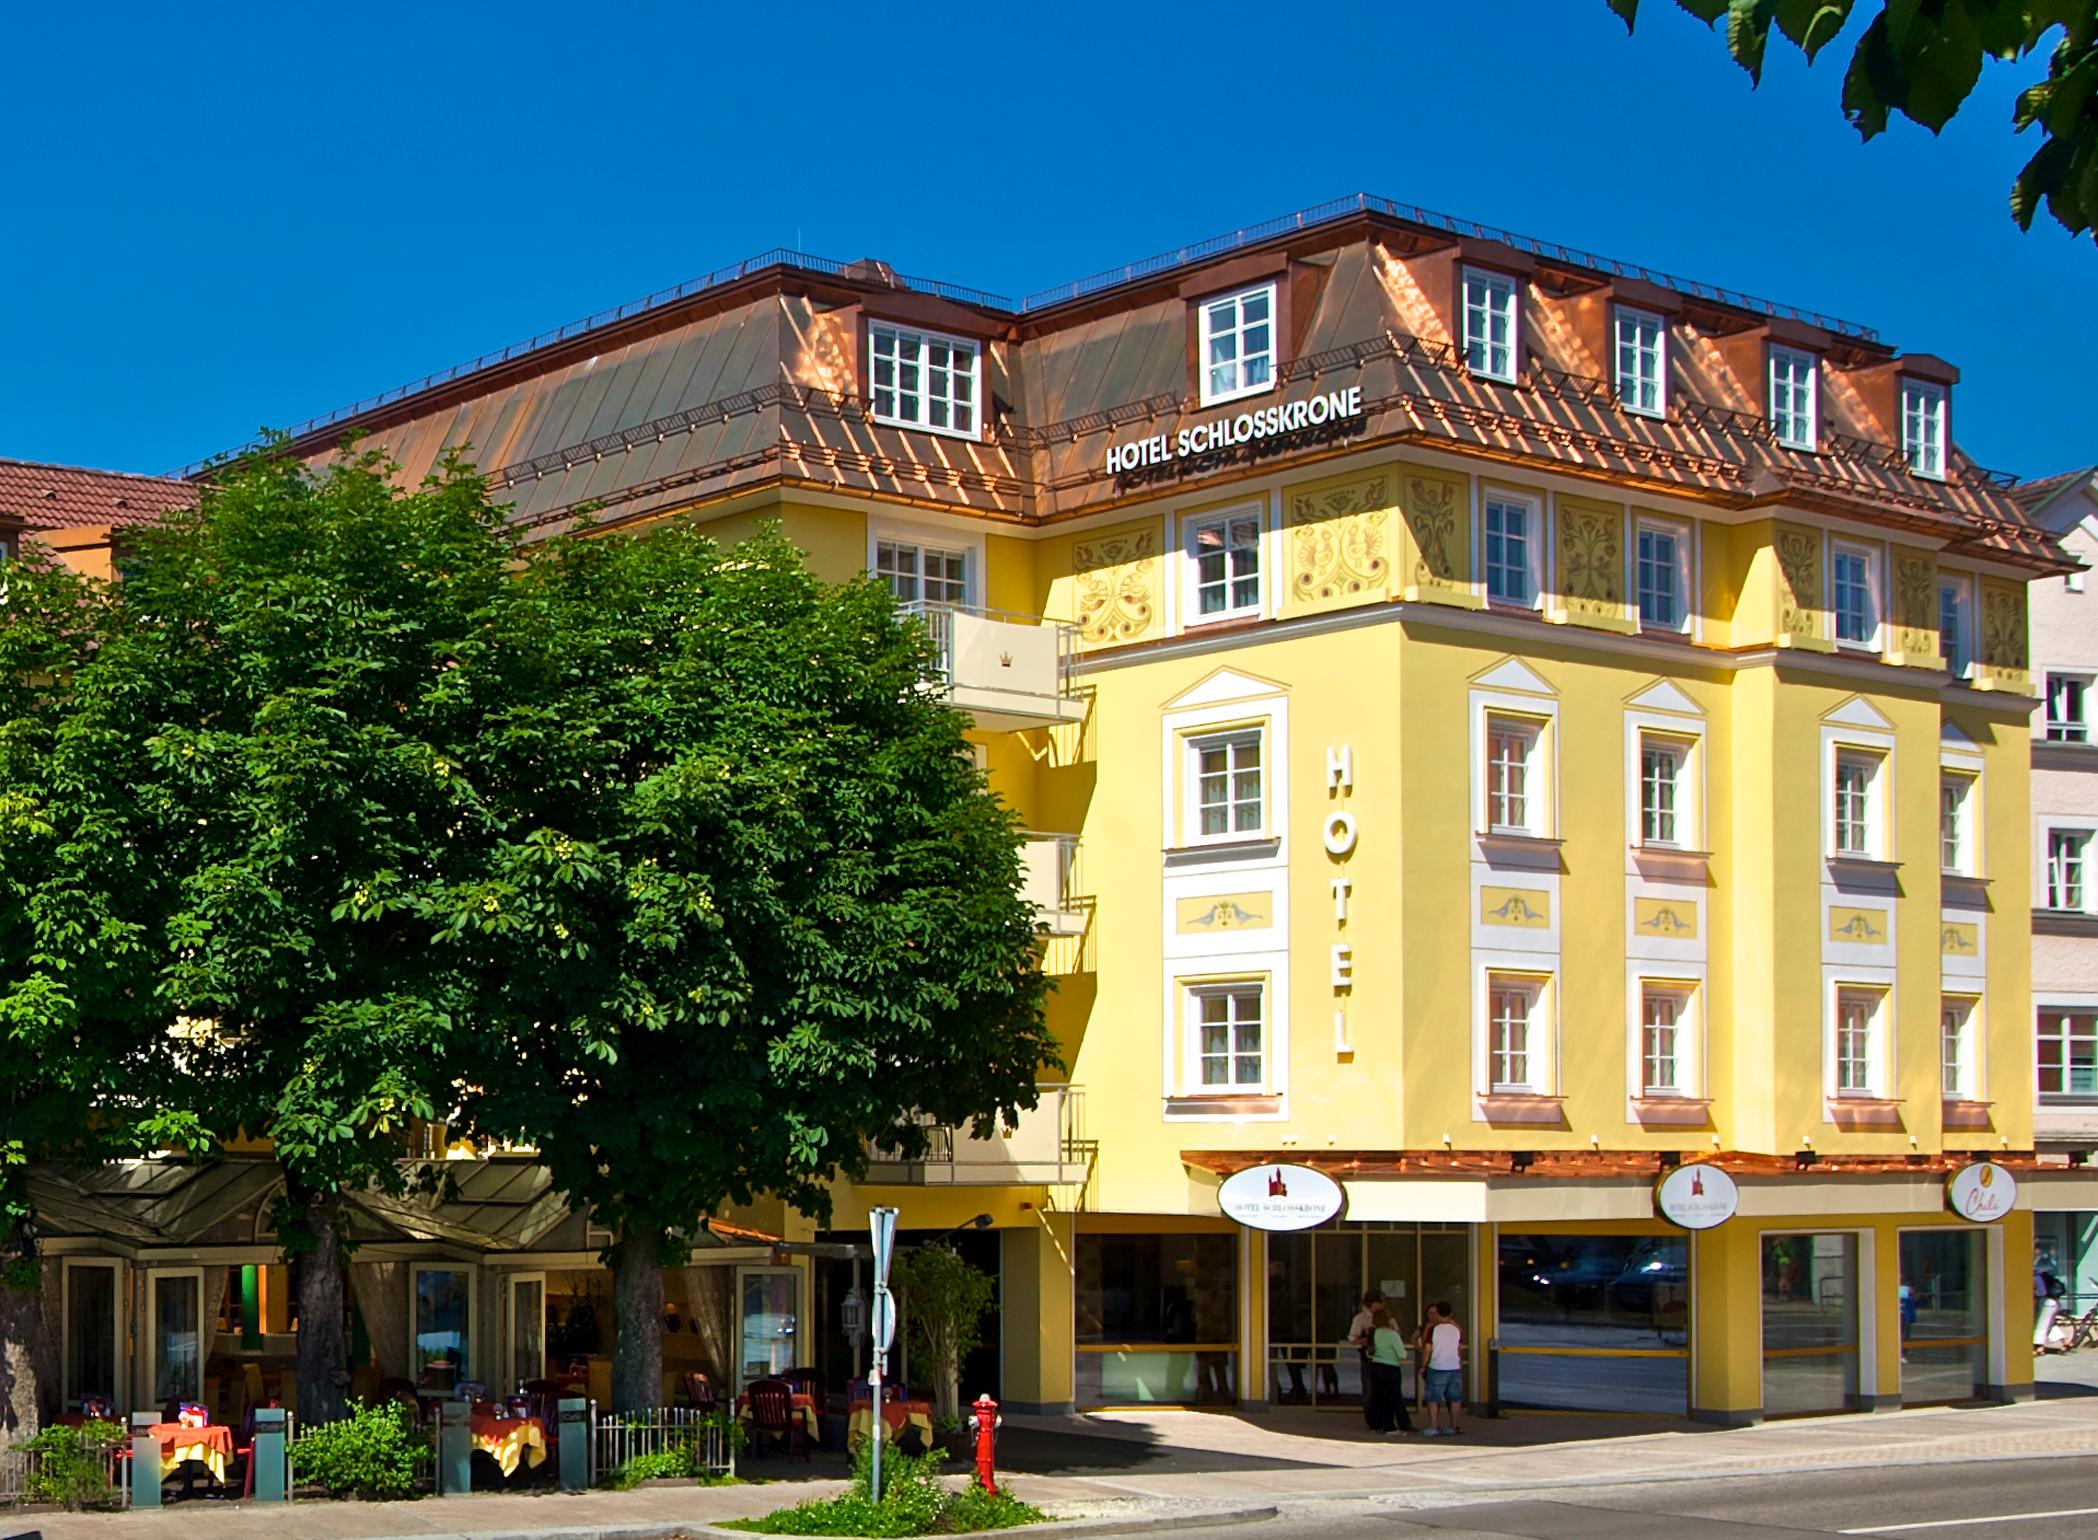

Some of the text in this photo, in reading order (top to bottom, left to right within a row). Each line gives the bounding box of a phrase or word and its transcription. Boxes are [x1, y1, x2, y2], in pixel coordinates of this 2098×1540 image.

[1106, 386, 1362, 474] HOTEL SCHLOSSKRONE
[1323, 745, 1357, 1054] HOTEL
[1234, 1203, 1260, 1212] HOTEL
